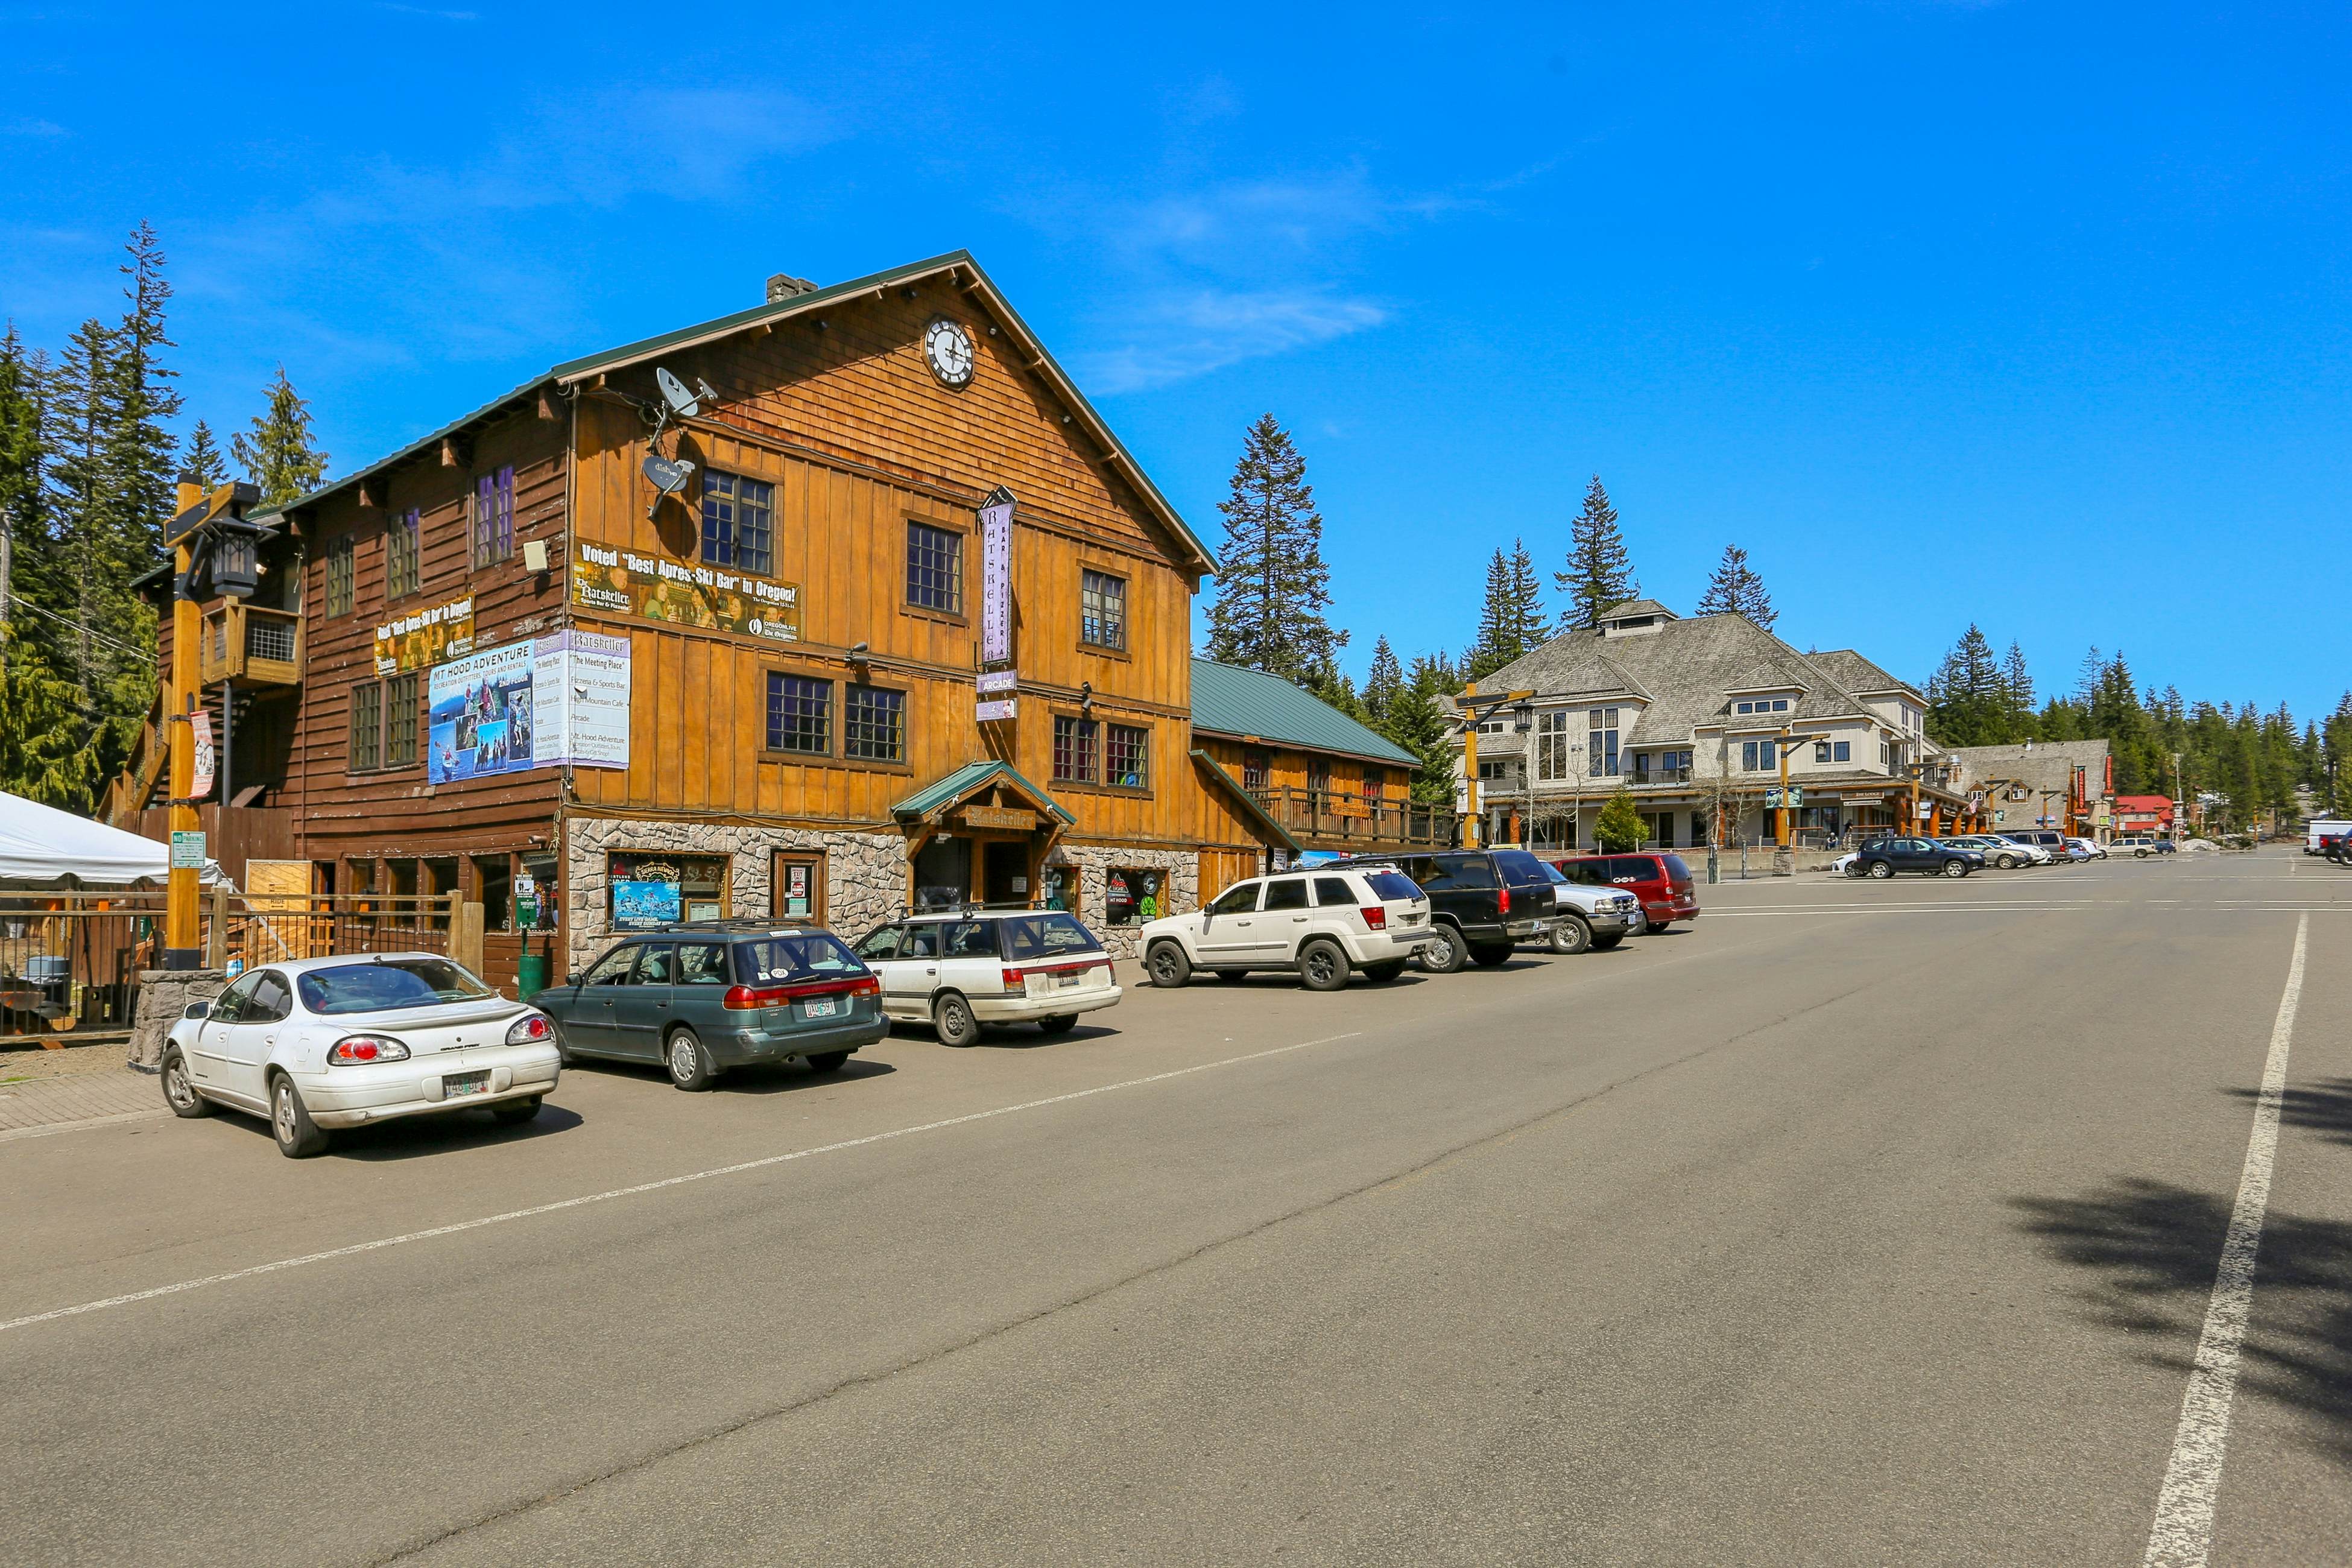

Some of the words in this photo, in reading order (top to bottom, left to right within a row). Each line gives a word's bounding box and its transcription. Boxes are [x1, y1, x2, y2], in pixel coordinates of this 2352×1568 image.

[655, 463, 670, 473] dish
[581, 543, 618, 567] Voted
[622, 553, 655, 575] "Best
[658, 559, 713, 586] Apres-Ski
[716, 572, 739, 590] Bar"
[742, 577, 753, 594] in
[756, 580, 795, 602] Oregon!
[575, 578, 588, 587] The
[987, 510, 996, 660] RATSKELLER
[581, 585, 630, 604] Ratskeller
[764, 621, 797, 631] OREGONLIVE
[774, 630, 797, 640] Oregonian
[574, 633, 624, 651] Ratskeller
[434, 670, 445, 681] MT
[447, 662, 470, 677] HOOD
[473, 645, 529, 671] ADVENTURE
[585, 657, 607, 669] Meeting
[434, 680, 457, 690] RECREATION
[482, 669, 496, 678] TOURS
[498, 666, 507, 674] AND
[507, 660, 526, 671] RENTALS
[499, 679, 510, 688] 2ND
[511, 674, 528, 685] FLOOR
[571, 676, 591, 684] Pizzeria
[599, 680, 615, 688] Sports
[984, 679, 1012, 691] ARCADE
[587, 698, 611, 706] Mountain
[598, 735, 625, 744] Adventure
[970, 808, 1034, 826] Ratskeller
[641, 866, 657, 876] SIERRA
[657, 866, 674, 876] NEVADA
[823, 1001, 835, 1011] 591
[446, 1080, 463, 1092] 748
